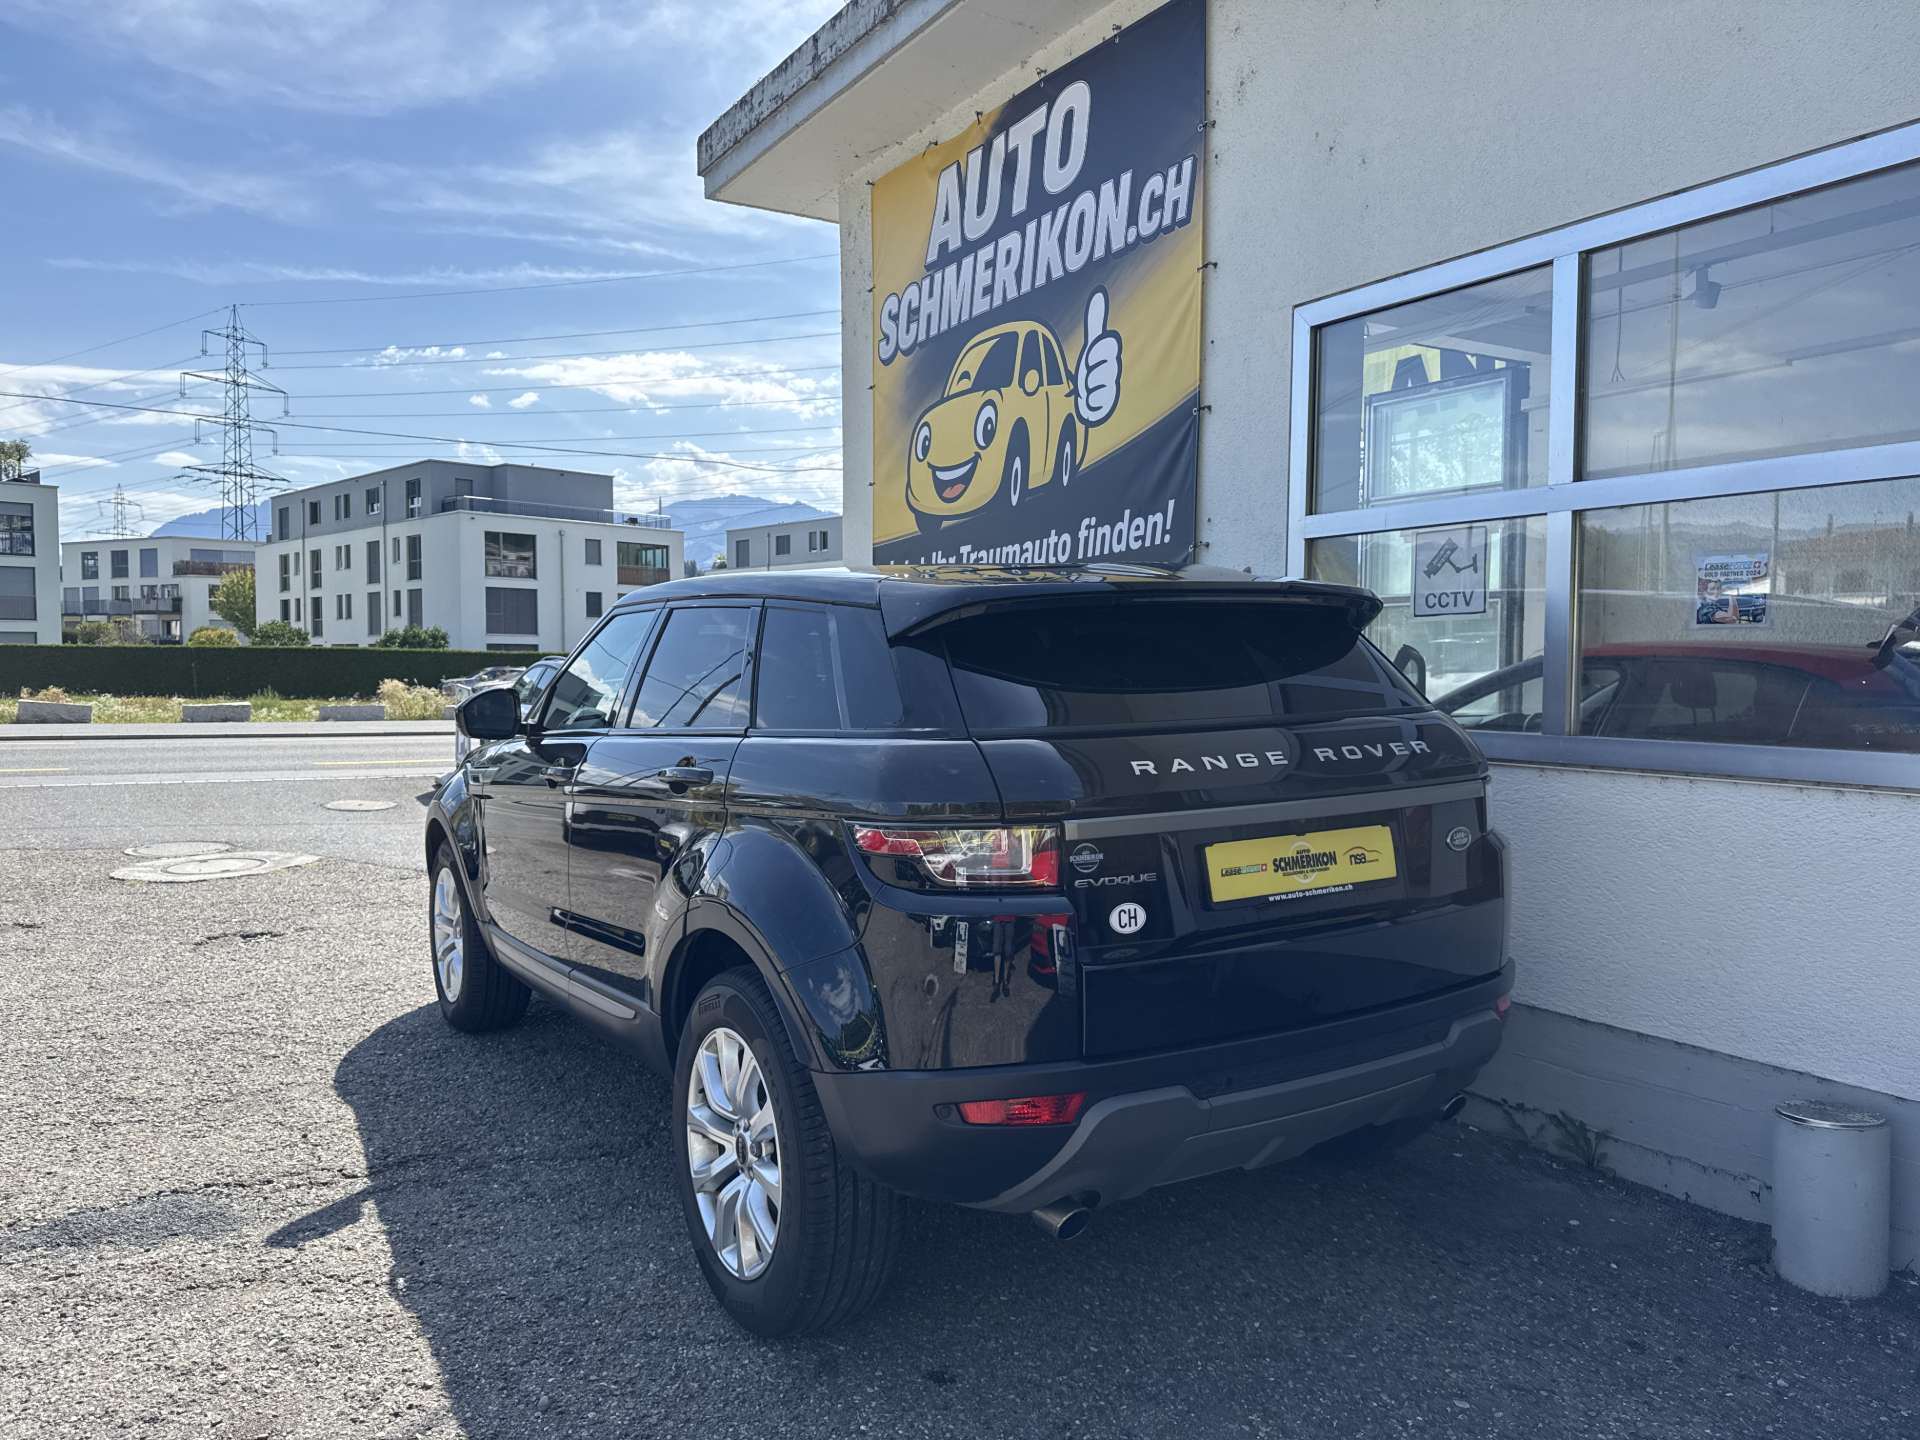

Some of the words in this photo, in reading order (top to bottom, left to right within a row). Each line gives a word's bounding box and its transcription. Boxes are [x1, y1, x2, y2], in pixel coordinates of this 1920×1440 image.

[926, 80, 1091, 265] AUTO
[878, 155, 1195, 361] SCHMERIKON.CH
[1077, 499, 1175, 559] finden!
[1425, 591, 1474, 609] CCTV
[1130, 750, 1289, 776] RANGE
[1313, 740, 1431, 762] ROVER
[1272, 850, 1338, 873] SCHMERIKON
[1074, 872, 1157, 888] EVOQUE
[1268, 884, 1354, 902] www.auto-schmerikon.ch
[1118, 908, 1138, 929] CH
